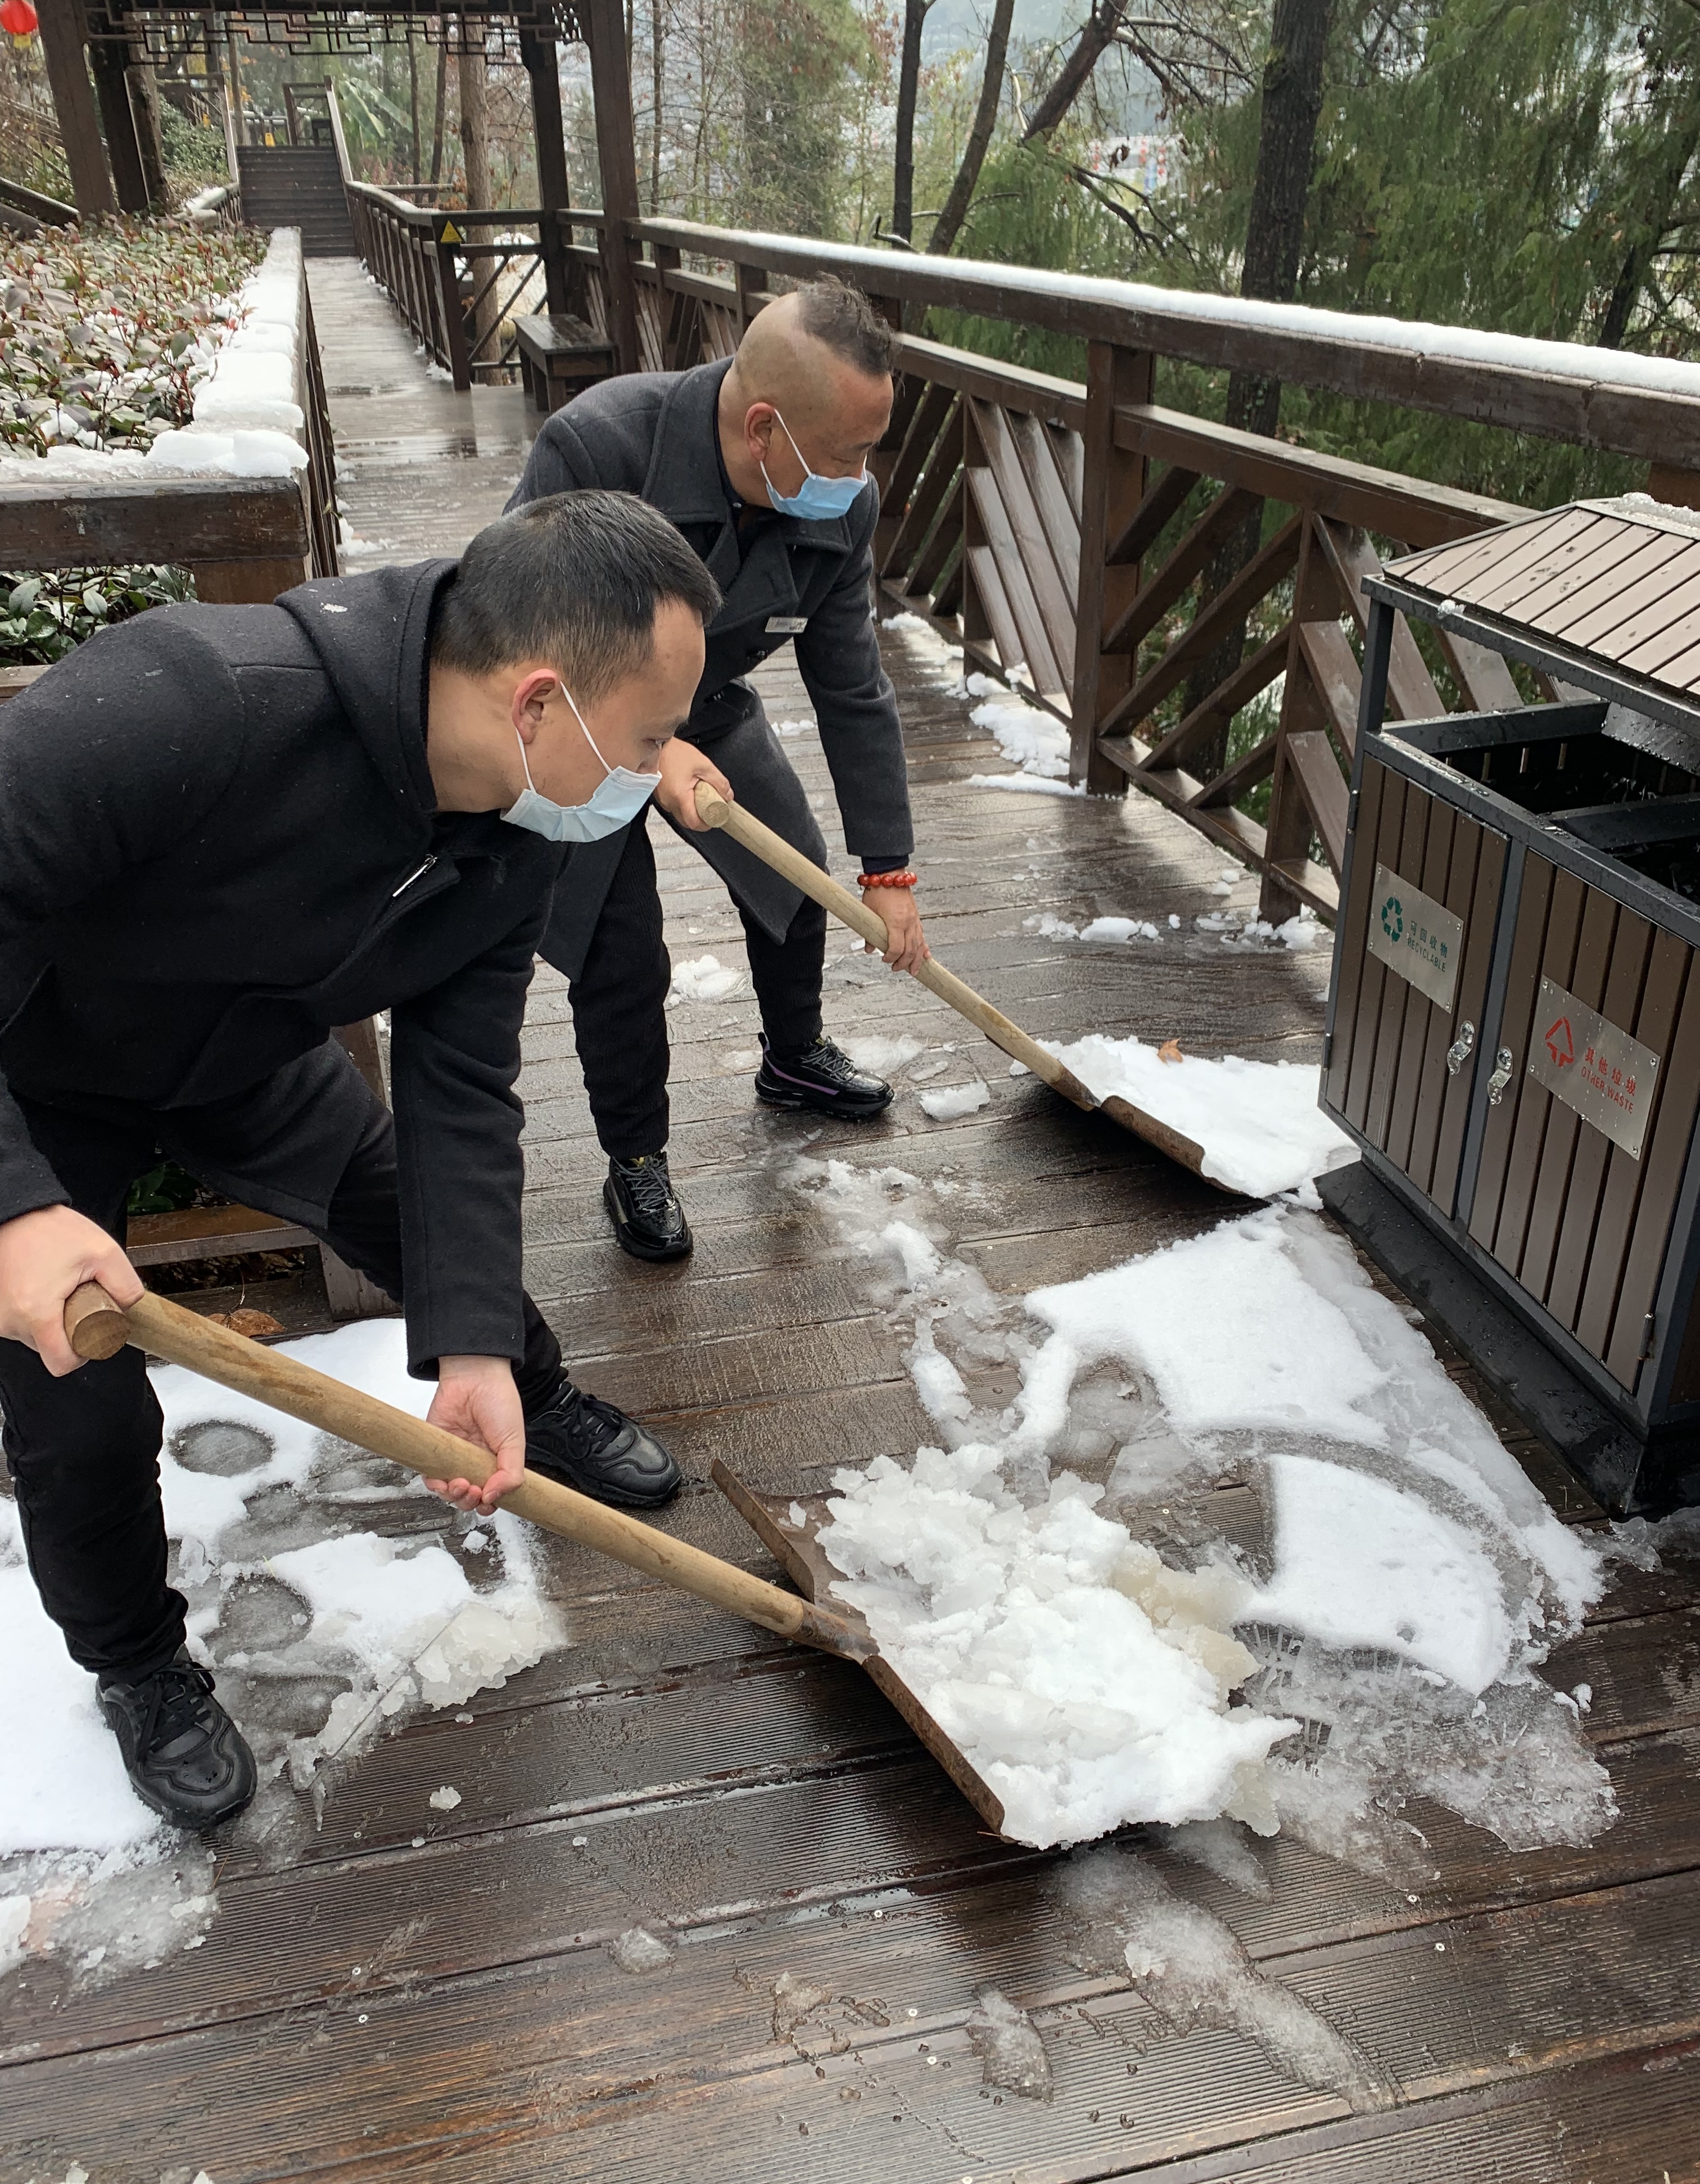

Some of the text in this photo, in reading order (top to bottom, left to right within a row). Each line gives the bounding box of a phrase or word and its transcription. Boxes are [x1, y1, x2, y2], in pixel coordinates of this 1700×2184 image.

[1408, 937, 1446, 972] RECYCLABLE
[1410, 920, 1448, 958] 可回收物
[1581, 1066, 1634, 1114] OTHER WASTE
[1585, 1047, 1636, 1097] 其他垃圾
